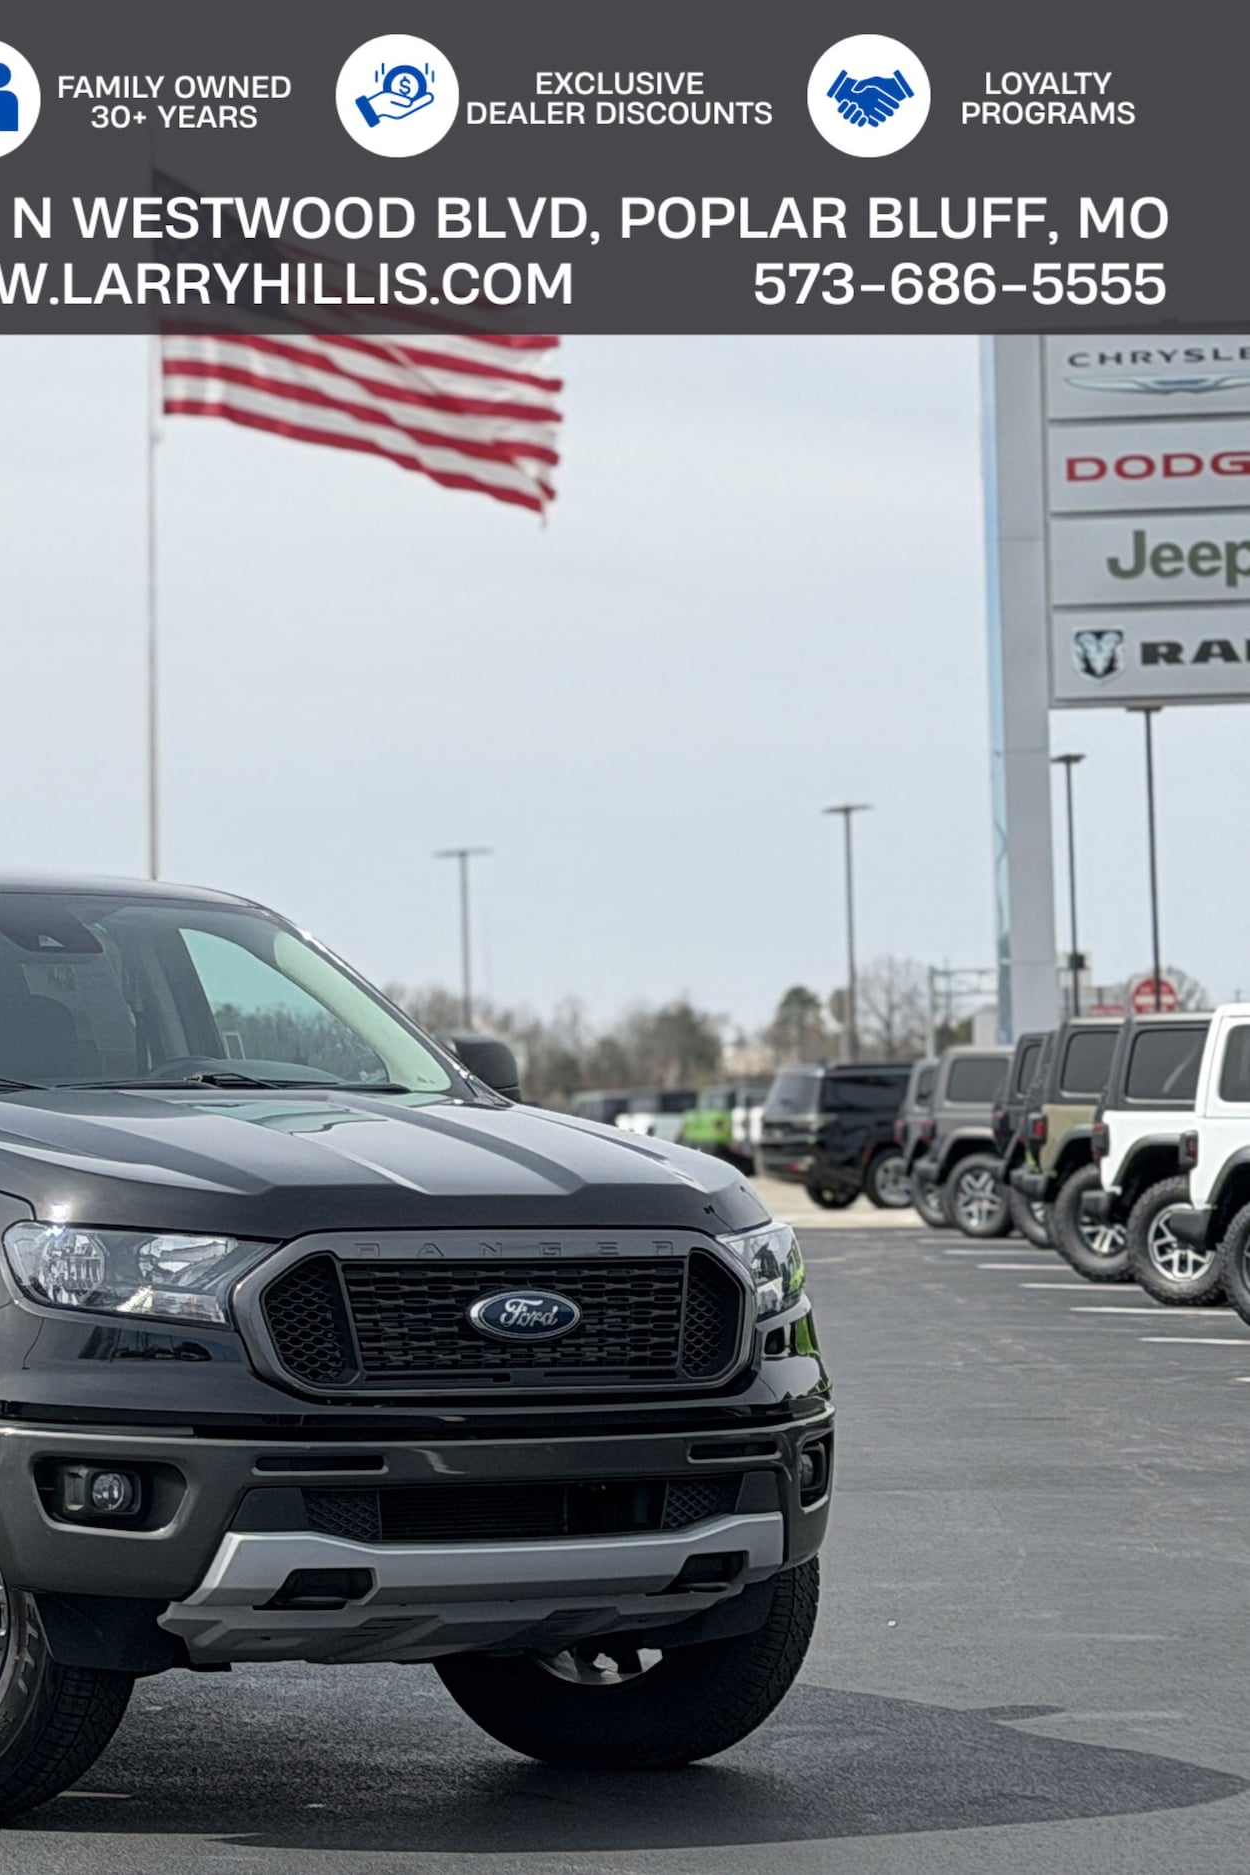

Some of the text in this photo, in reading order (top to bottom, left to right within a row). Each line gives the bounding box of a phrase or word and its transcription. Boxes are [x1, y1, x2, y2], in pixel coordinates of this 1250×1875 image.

[1141, 639, 1250, 665] RA
[355, 1241, 674, 1257] RANGER
[499, 1297, 559, 1328] Ford
